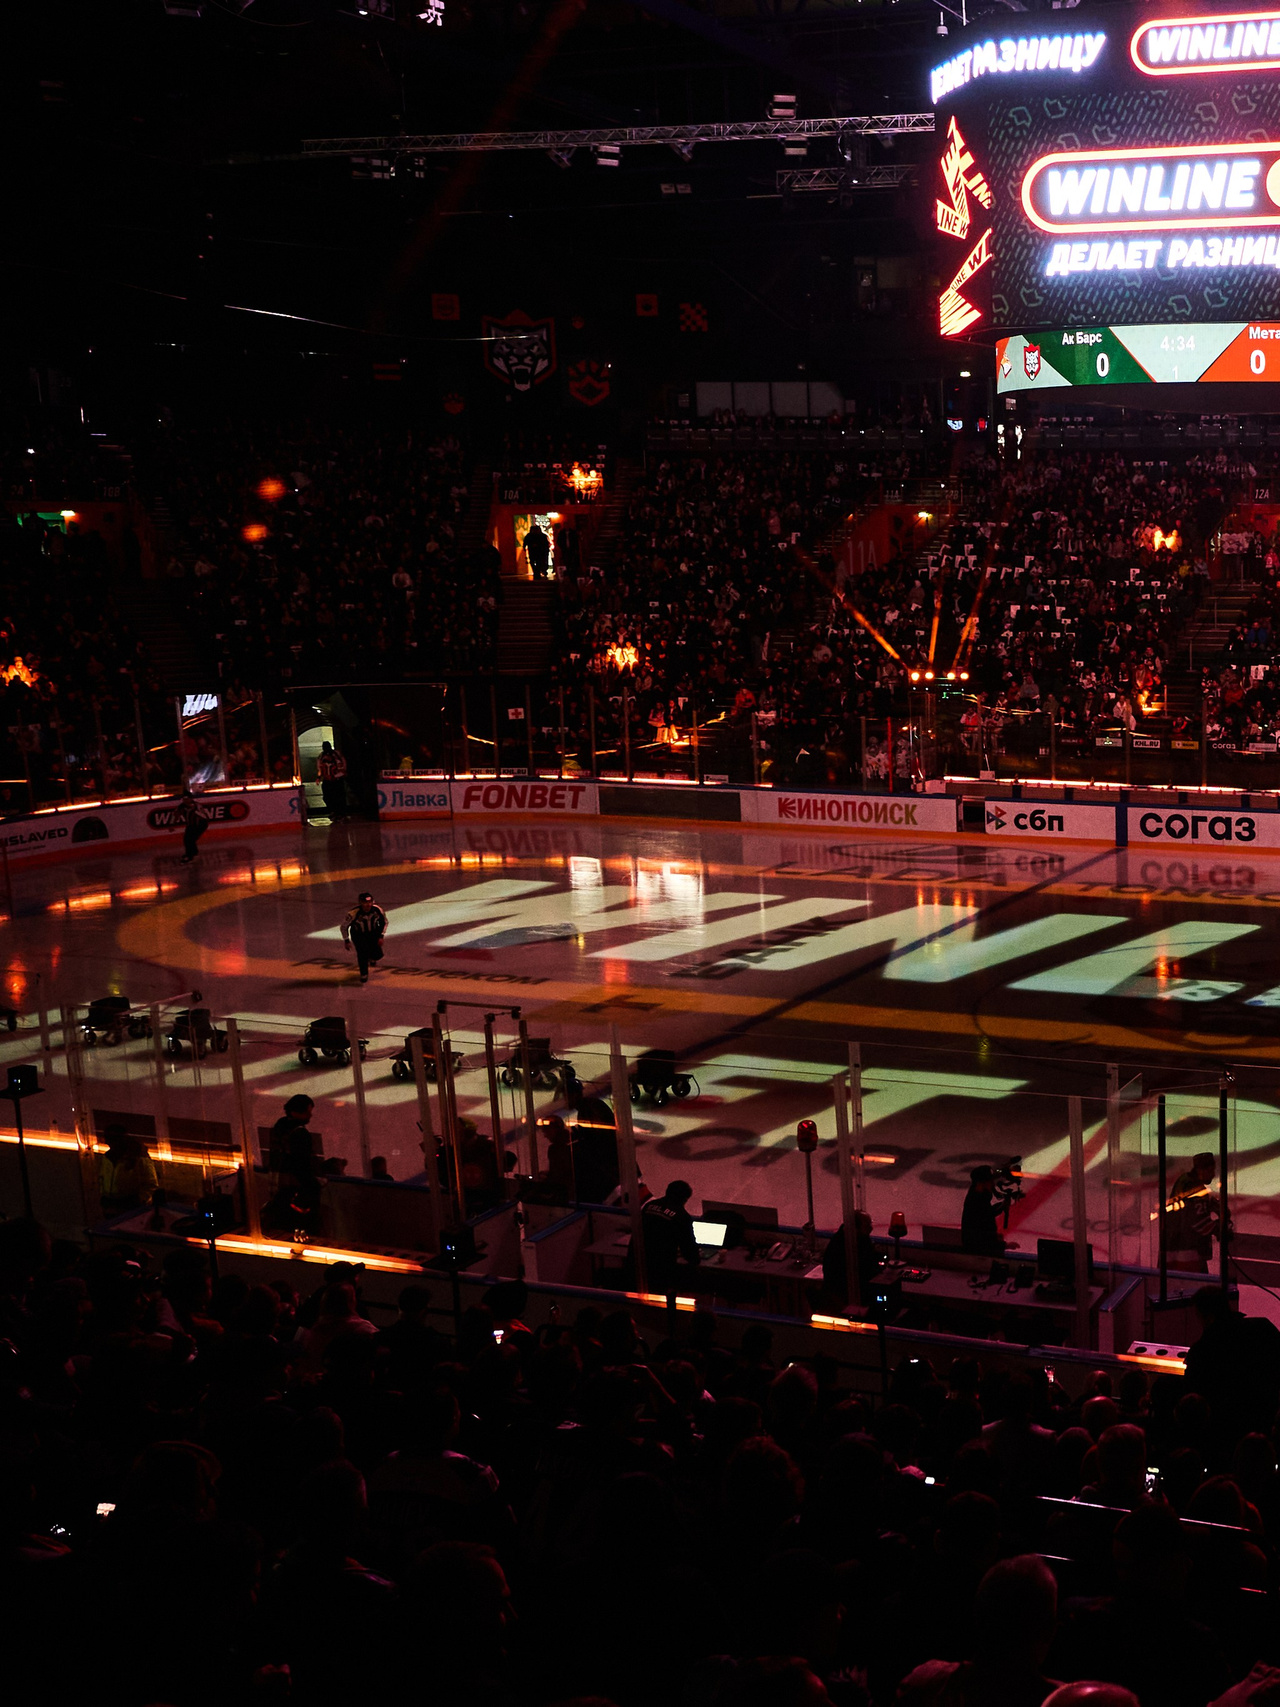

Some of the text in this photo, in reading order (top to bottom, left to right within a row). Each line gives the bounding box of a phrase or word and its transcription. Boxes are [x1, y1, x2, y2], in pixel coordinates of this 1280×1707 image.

[1049, 160, 1261, 215] WINLINE
[1046, 239, 1163, 276] ДЕЛАЕТ
[1062, 331, 1102, 345] Ак Барс
[1160, 335, 1195, 351] 4:34
[1096, 353, 1109, 377] 0
[1172, 366, 1179, 379] 1
[1250, 350, 1266, 374] 0
[1255, 488, 1270, 499] 12A
[847, 540, 879, 577] 11A
[391, 791, 447, 807] Лавка
[463, 785, 586, 809] FONBET
[778, 797, 918, 826] КИНОПОИСК
[1014, 810, 1064, 832] сбп
[1140, 813, 1256, 842] согаз
